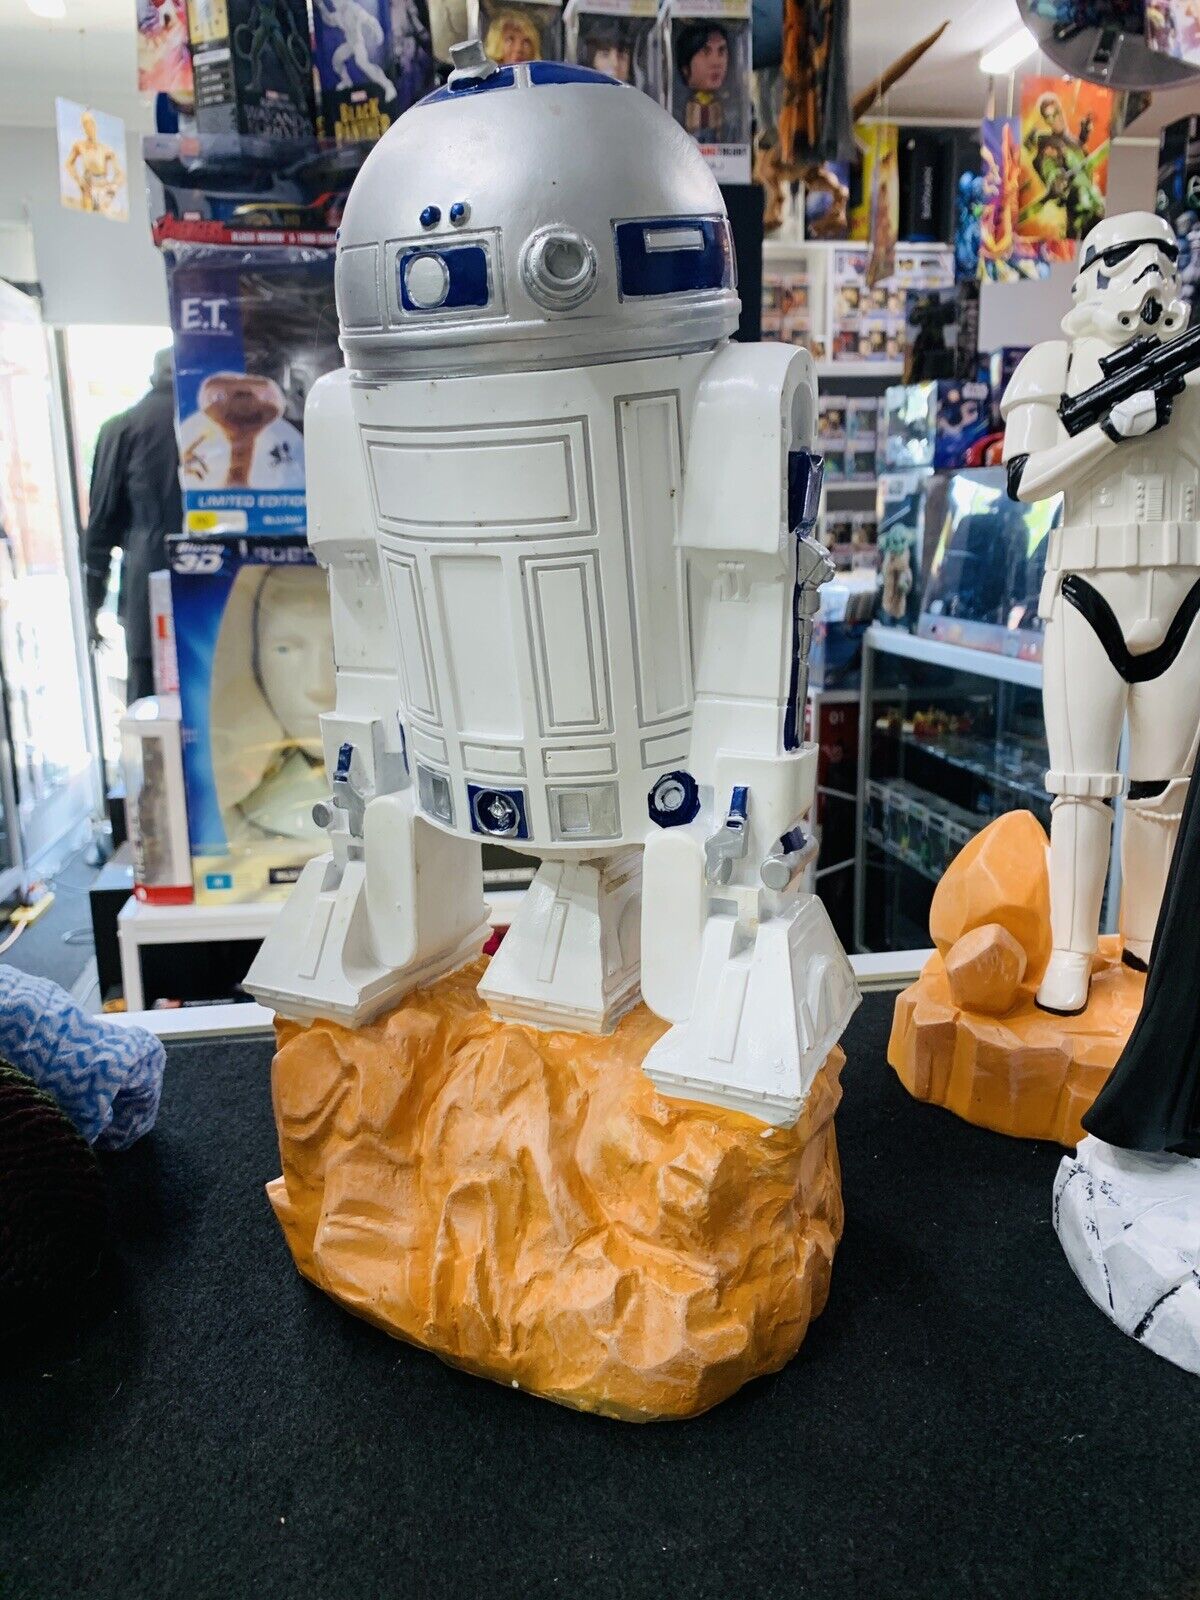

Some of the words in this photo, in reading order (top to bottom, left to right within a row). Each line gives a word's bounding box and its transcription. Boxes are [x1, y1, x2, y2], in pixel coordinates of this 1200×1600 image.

[340, 97, 380, 121] BLACK
[181, 297, 229, 331] E.T.
[197, 494, 255, 508] LIMITED
[257, 494, 306, 508] EDITIO
[172, 553, 224, 575] 3D
